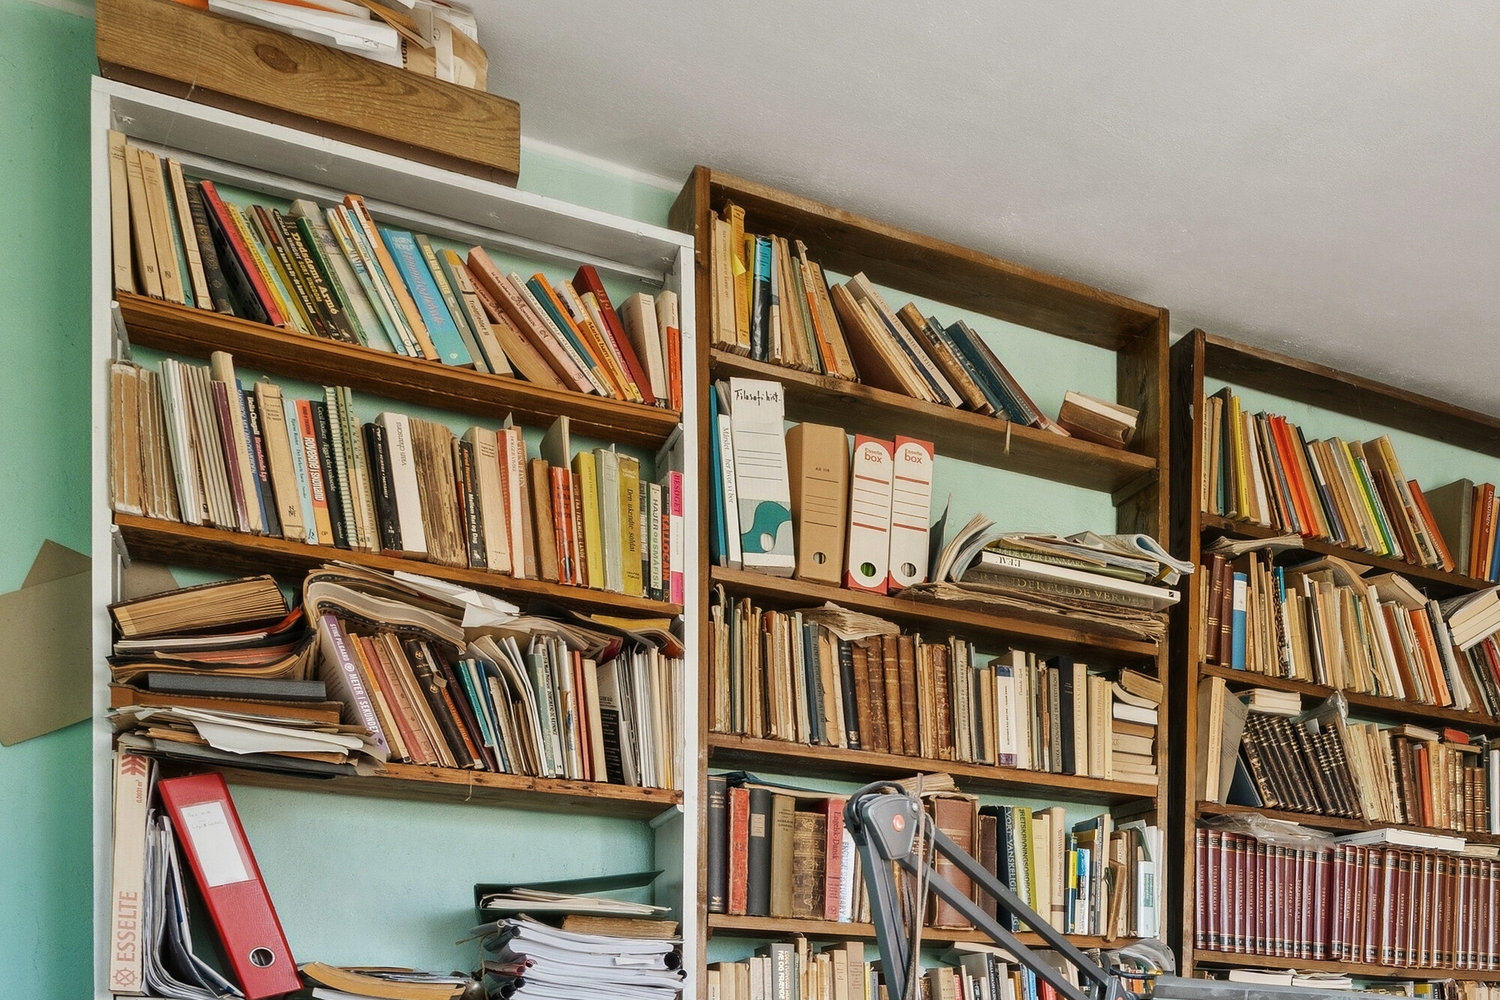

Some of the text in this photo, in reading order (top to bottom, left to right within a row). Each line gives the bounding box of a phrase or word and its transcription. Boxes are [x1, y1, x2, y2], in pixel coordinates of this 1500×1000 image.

[290, 230, 322, 284] Dødsdømt
[864, 453, 882, 464] box
[905, 453, 923, 464] box
[653, 544, 661, 587] SMÅFISK
[662, 514, 670, 581] KALLOCAIN
[329, 623, 380, 734] STINE PILGAARD METER SEKUNDET
[117, 891, 138, 963] ESSELTE
